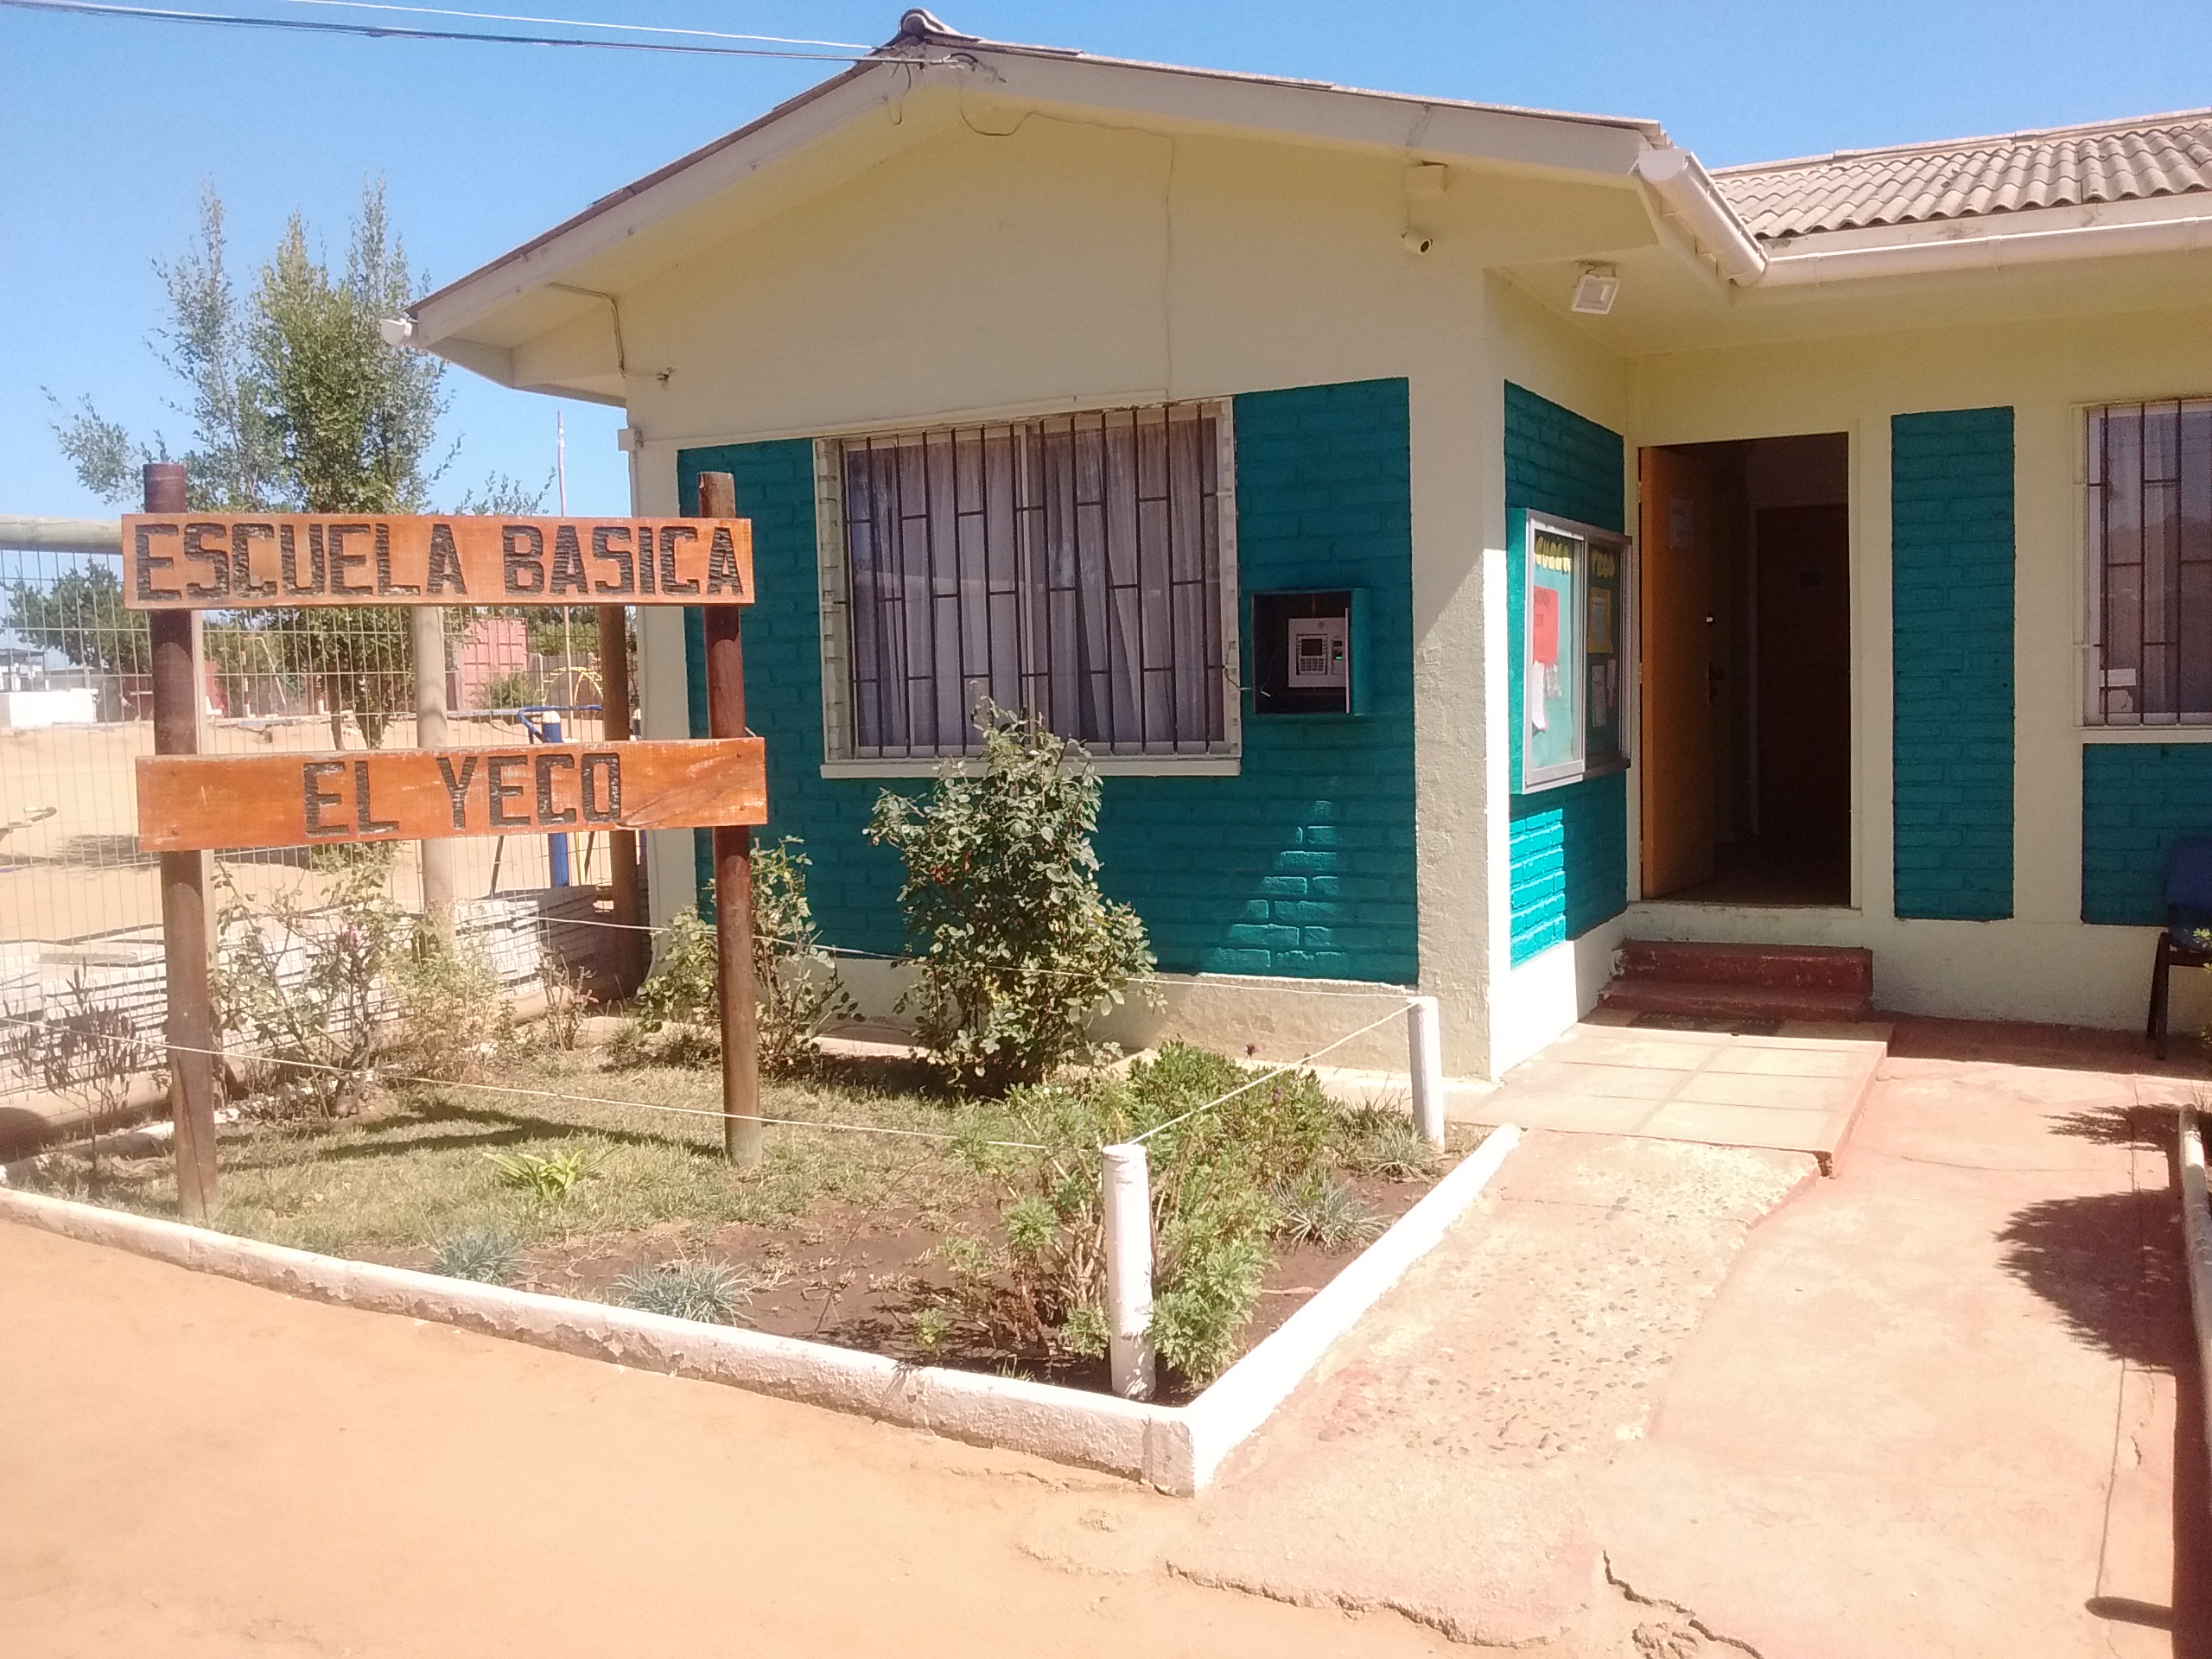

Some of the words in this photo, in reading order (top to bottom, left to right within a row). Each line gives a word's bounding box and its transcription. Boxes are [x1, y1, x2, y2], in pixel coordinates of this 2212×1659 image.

[135, 523, 466, 601] ESCUELA
[502, 524, 744, 596] BASICA
[302, 760, 400, 837] EL
[436, 753, 622, 829] YECO
